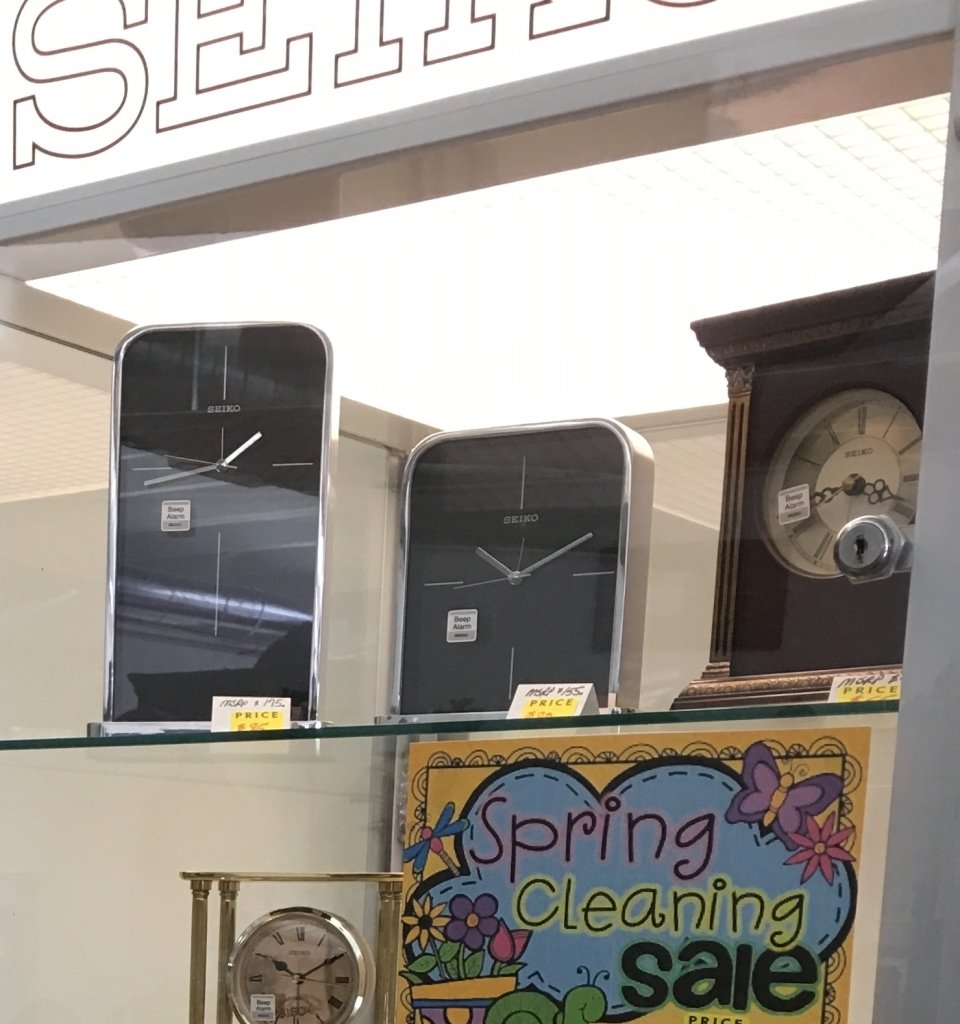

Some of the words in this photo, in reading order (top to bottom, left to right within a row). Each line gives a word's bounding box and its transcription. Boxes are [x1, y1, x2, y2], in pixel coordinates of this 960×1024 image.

[207, 404, 241, 413] SEIKO
[845, 448, 874, 458] SEIKO
[785, 492, 803, 503] Beep
[167, 506, 185, 514] Beep
[784, 500, 805, 511] Alarm
[166, 512, 185, 520] Alarm
[503, 514, 539, 524] SEIKO
[453, 616, 471, 624] Beep
[843, 686, 898, 694] PRICE
[530, 698, 574, 707] PRICE
[235, 711, 279, 719] PRICE
[470, 794, 717, 882] Spring
[514, 878, 807, 948] Cleaning
[621, 938, 819, 1013] sale
